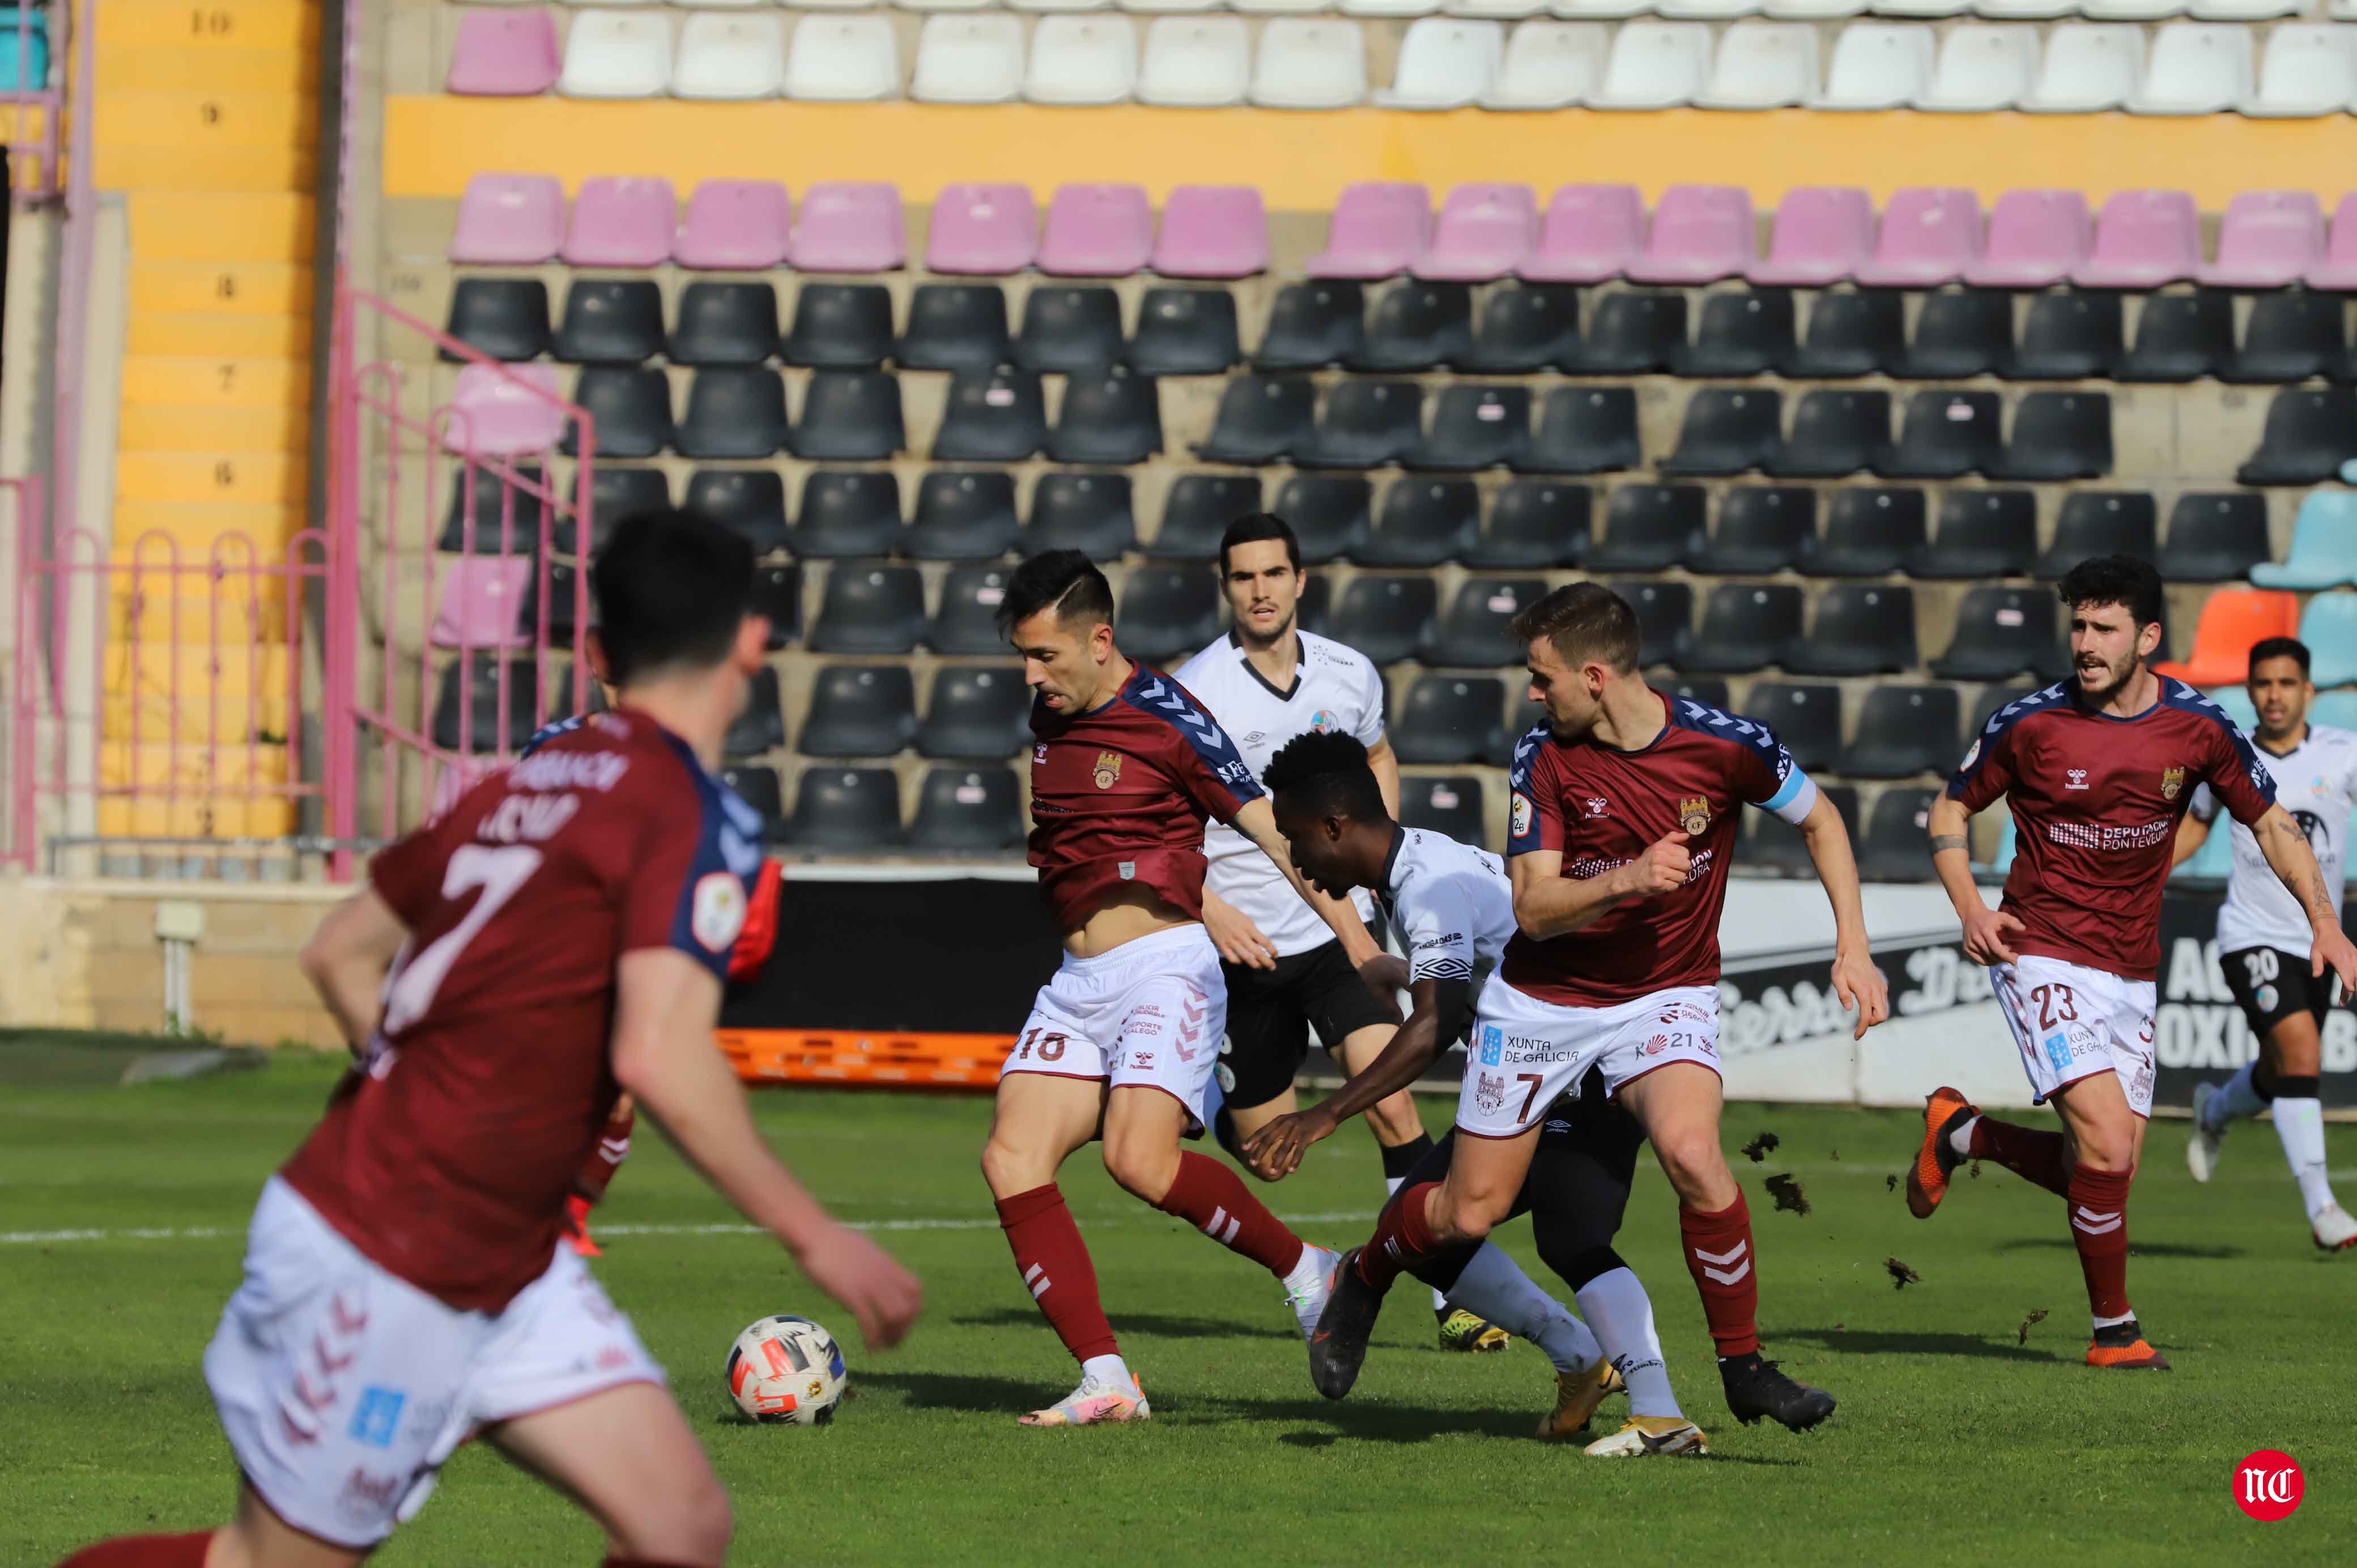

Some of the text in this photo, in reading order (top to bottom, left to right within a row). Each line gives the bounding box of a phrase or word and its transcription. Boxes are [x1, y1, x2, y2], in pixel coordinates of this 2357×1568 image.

[2244, 948, 2279, 989] 20
[2031, 983, 2078, 1032] 23
[1507, 1036, 1551, 1051] XUNTA
[1670, 1032, 1692, 1049] 21
[1504, 1050, 1580, 1063] DE GALICIA
[2071, 1045, 2086, 1058] DE
[1516, 1073, 1544, 1124] 7
